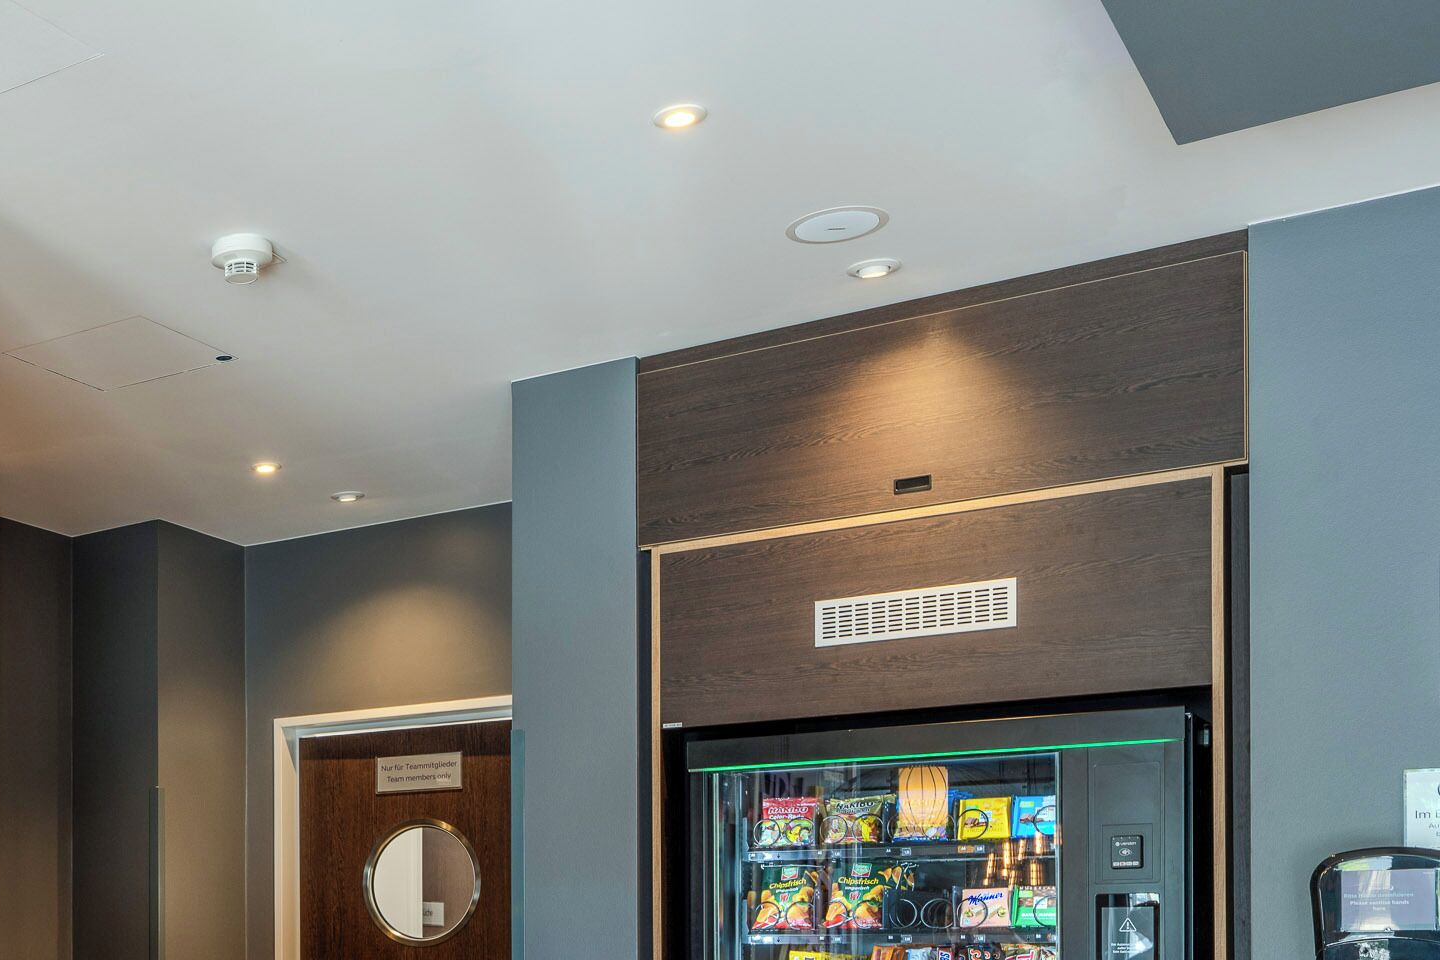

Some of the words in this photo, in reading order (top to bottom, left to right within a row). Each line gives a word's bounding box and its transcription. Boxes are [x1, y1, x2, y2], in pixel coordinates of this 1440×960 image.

[394, 763, 403, 771] für
[406, 760, 457, 771] Teammitglieder
[387, 775, 405, 783] Team
[769, 878, 807, 889] Chipsfrisch
[838, 876, 879, 885] Chipsfrisch
